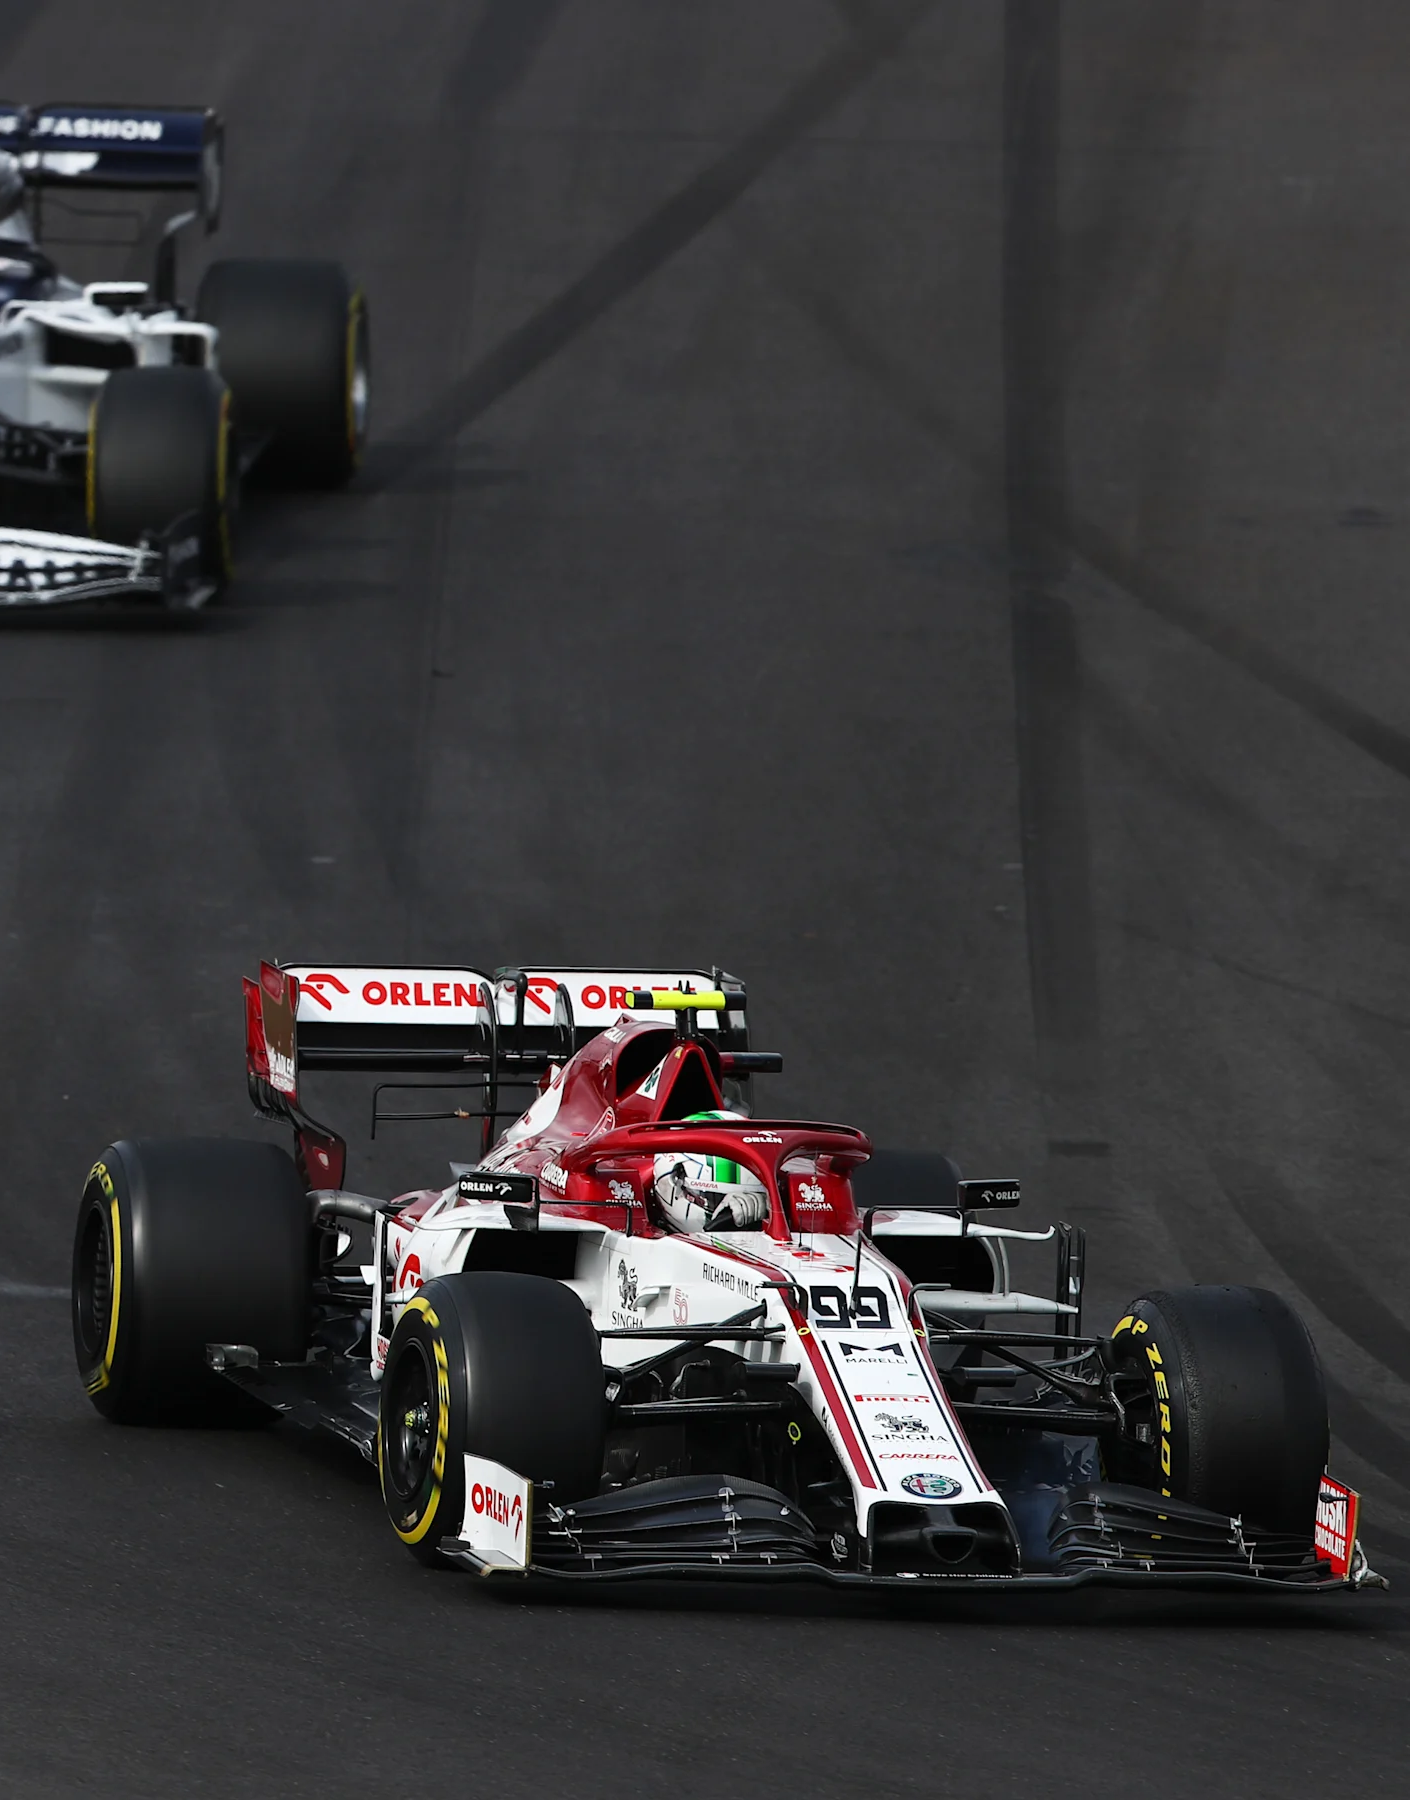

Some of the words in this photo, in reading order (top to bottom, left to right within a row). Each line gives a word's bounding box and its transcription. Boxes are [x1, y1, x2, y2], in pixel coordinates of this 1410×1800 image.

[361, 978, 484, 1008] ORLEN
[742, 1136, 783, 1144] ORLEN
[460, 1181, 494, 1193] ORLEN
[690, 1181, 719, 1189] CARRERA
[795, 1202, 833, 1210] SINGHA
[702, 1262, 736, 1292] RICHARD
[736, 1277, 761, 1302] MILLE
[809, 1285, 892, 1330] 99
[611, 1310, 644, 1329] SINGHA
[845, 1357, 909, 1366] MARELLI
[853, 1394, 931, 1404] PIRELLI
[1131, 1319, 1148, 1335] P
[1146, 1342, 1172, 1477] ZERO
[871, 1433, 949, 1443] SINGHA
[878, 1453, 960, 1462] CARRERA
[471, 1483, 510, 1528] ORLEN
